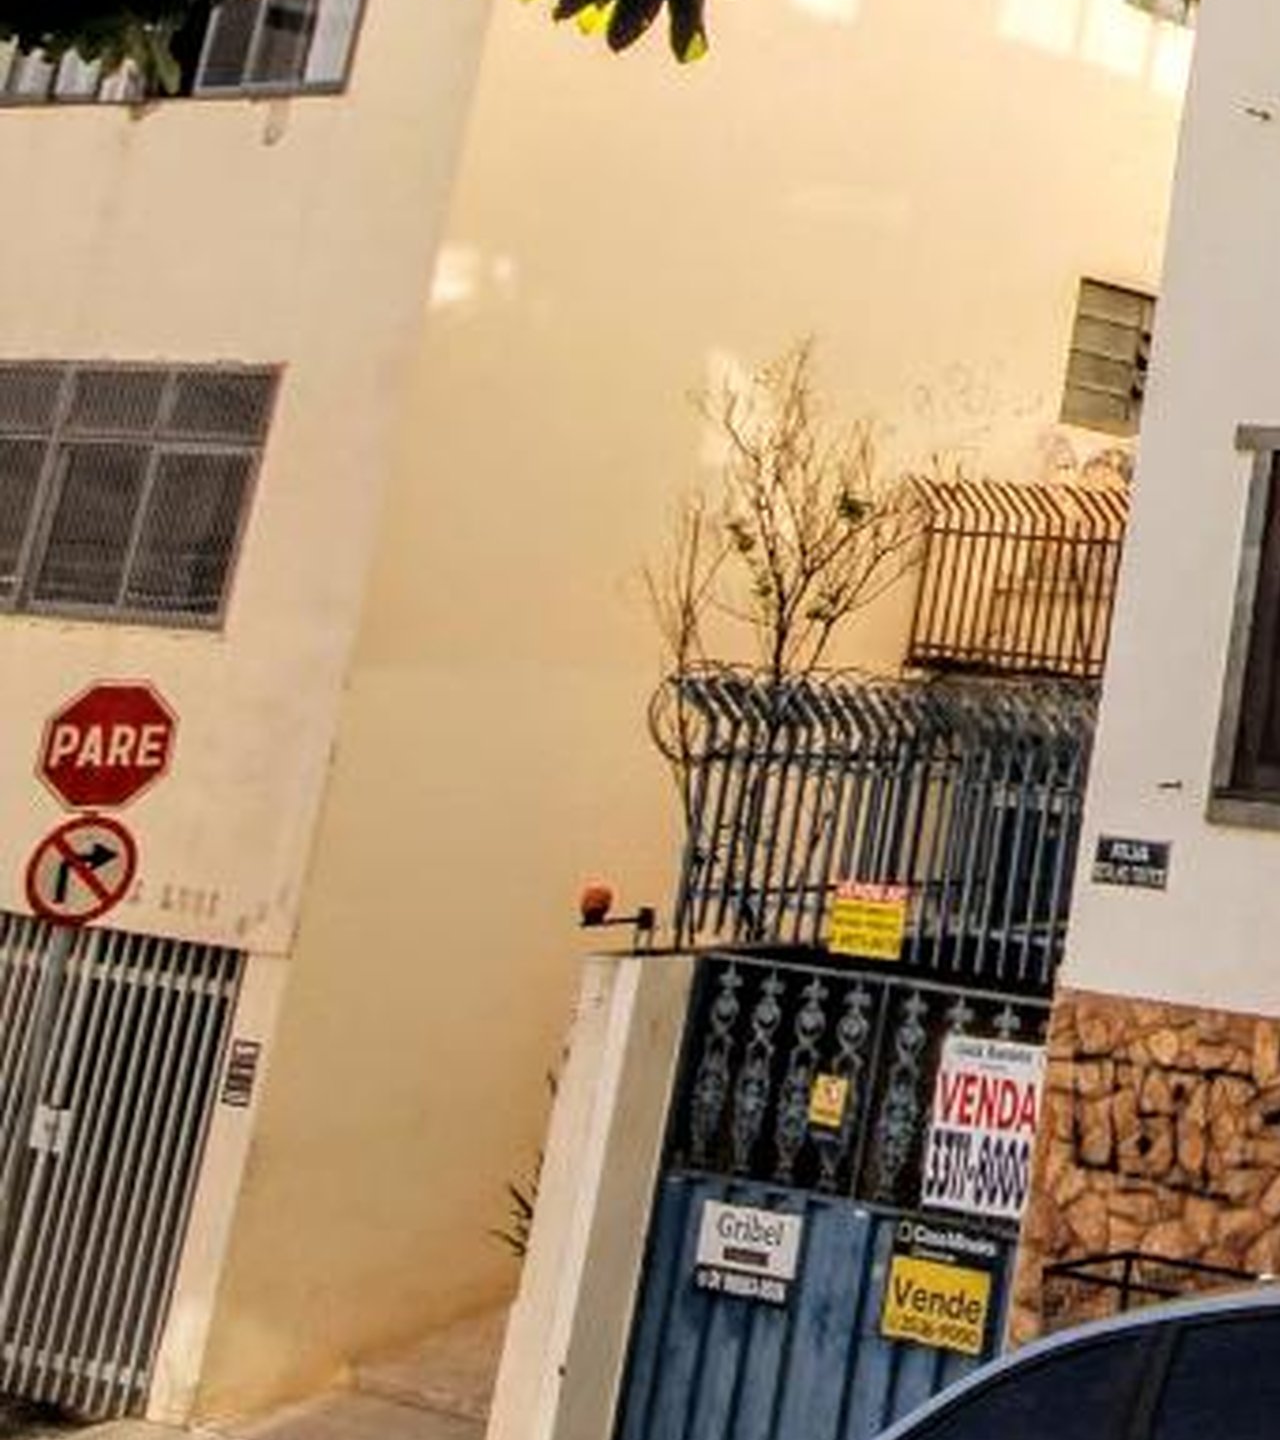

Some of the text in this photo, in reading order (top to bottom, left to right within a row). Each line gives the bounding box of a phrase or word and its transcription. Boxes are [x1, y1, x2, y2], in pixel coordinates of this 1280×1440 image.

[49, 722, 167, 769] PARE
[937, 1072, 1037, 1134] VENDA
[718, 1211, 785, 1247] Gribel
[894, 1273, 982, 1325] Vende
